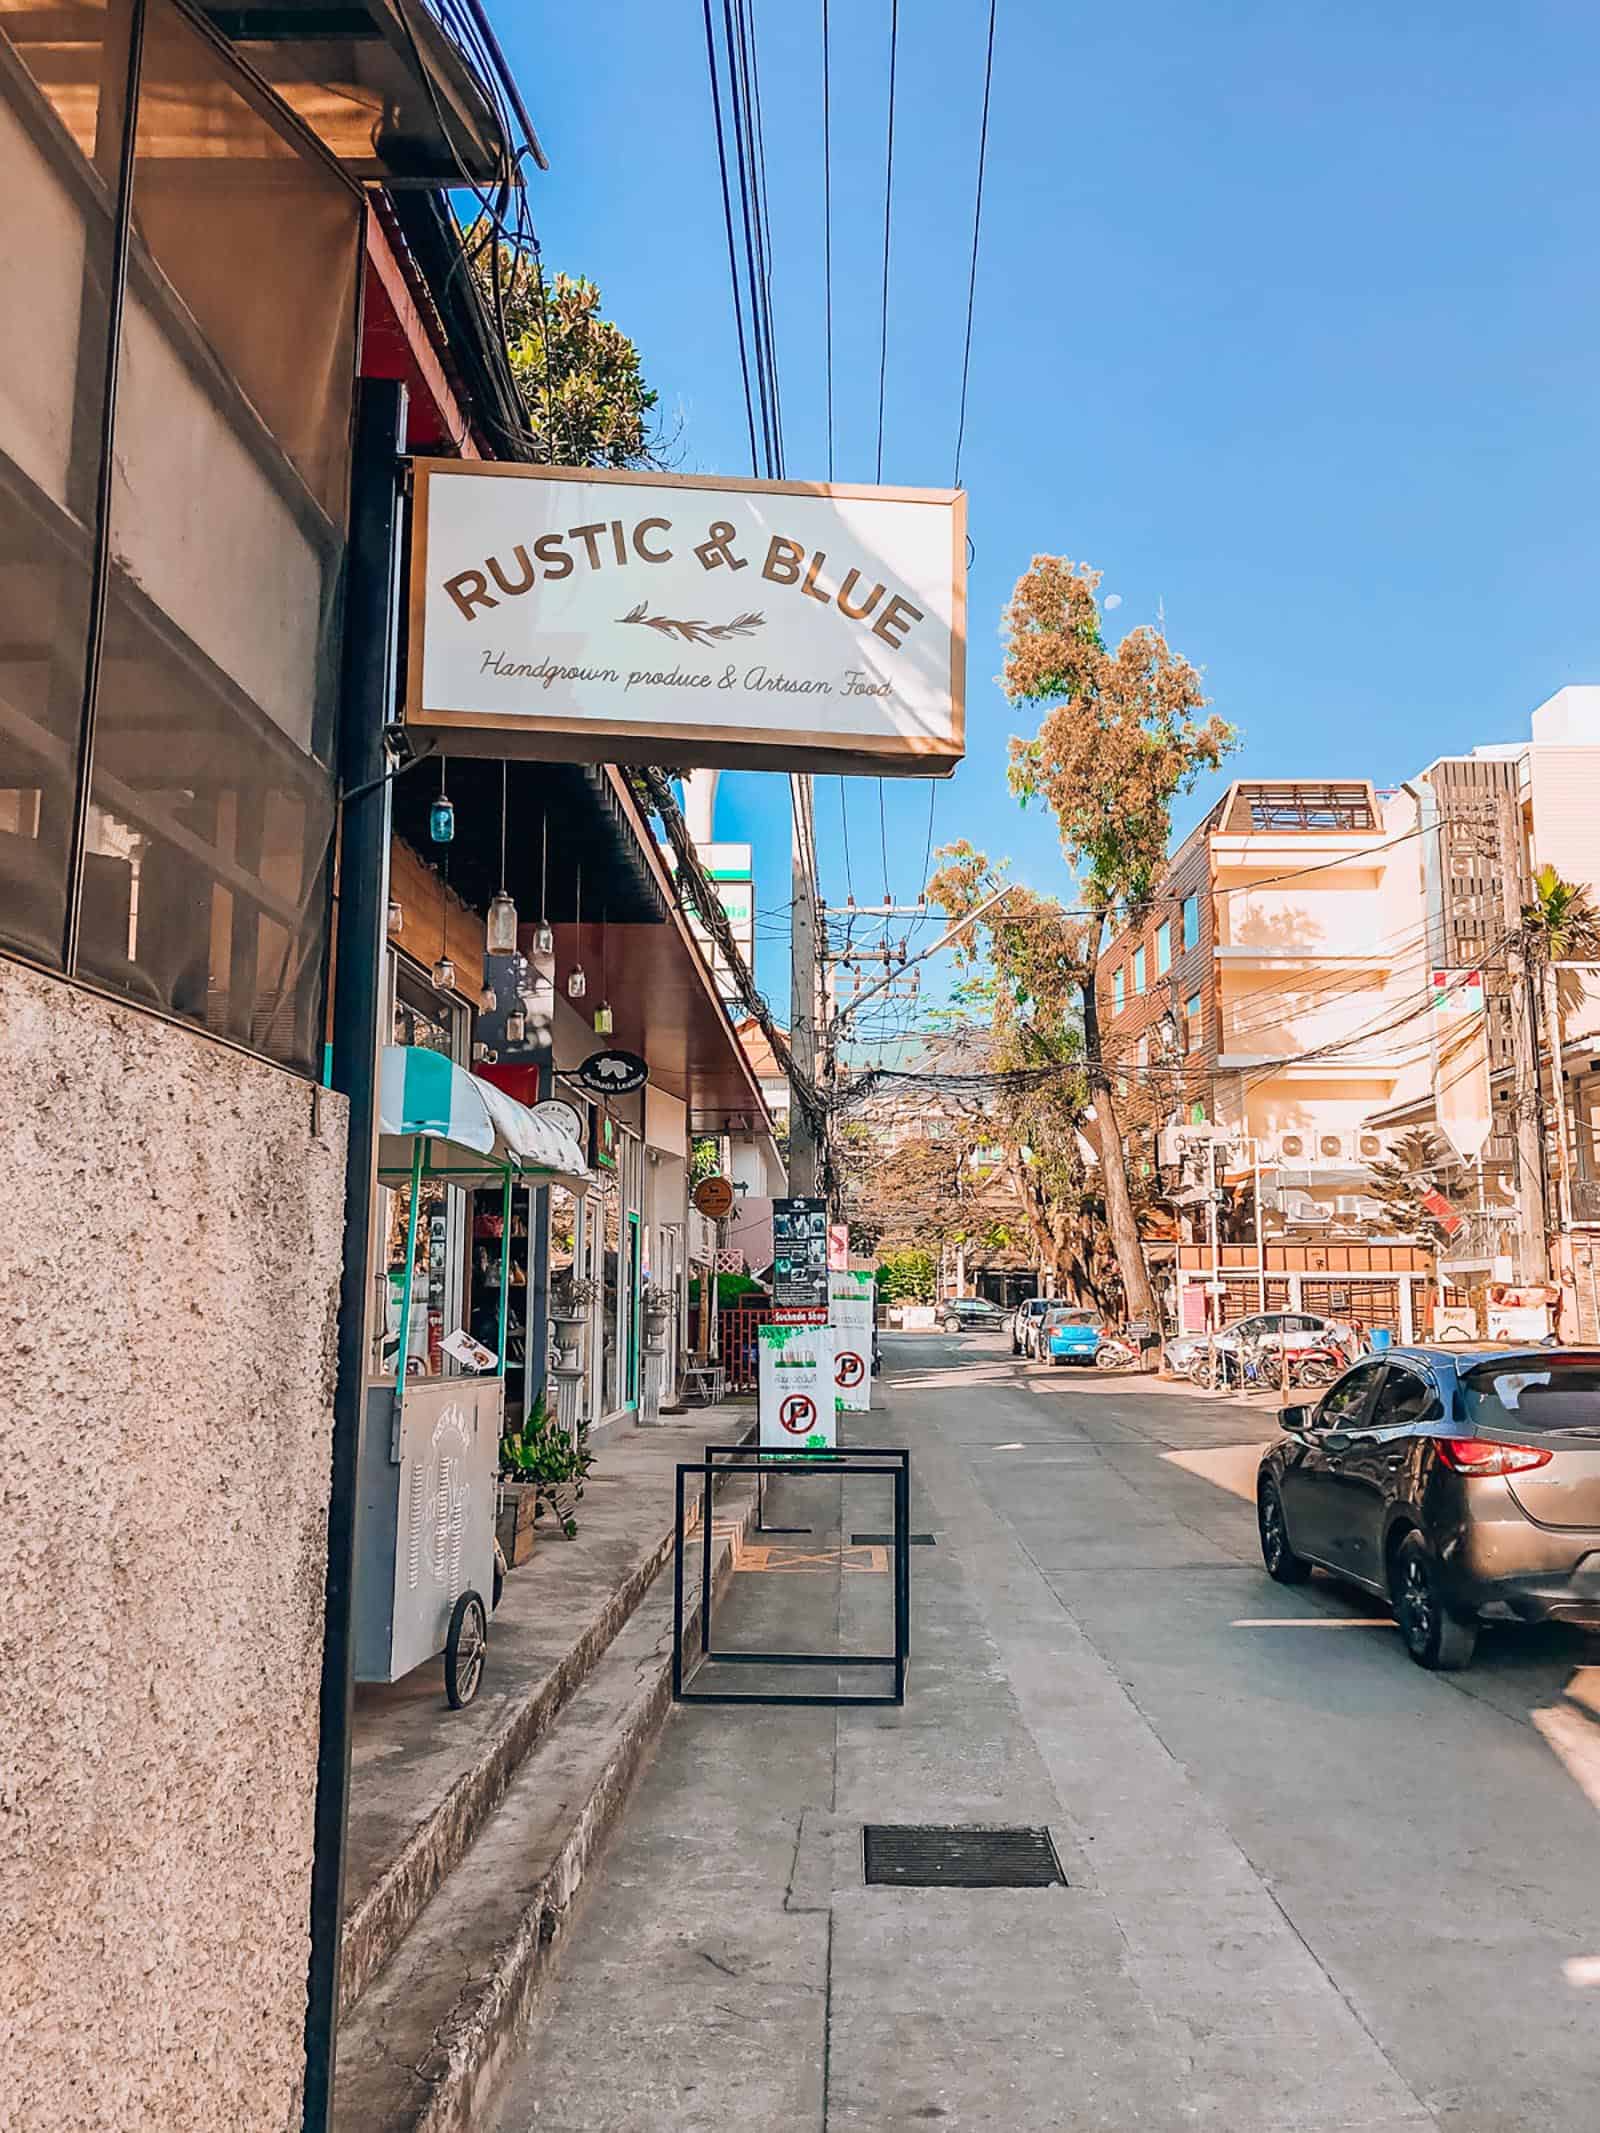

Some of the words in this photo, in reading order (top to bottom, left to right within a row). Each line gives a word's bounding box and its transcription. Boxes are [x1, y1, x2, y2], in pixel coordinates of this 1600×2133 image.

[443, 518, 673, 621] RUSTIC
[693, 521, 748, 571] &
[761, 535, 925, 650] BLUE
[479, 650, 620, 689] Handgrown
[624, 664, 712, 692] produce
[717, 664, 737, 689] &
[743, 666, 832, 694] Artisan
[839, 670, 895, 697] Food
[790, 1401, 810, 1428] P
